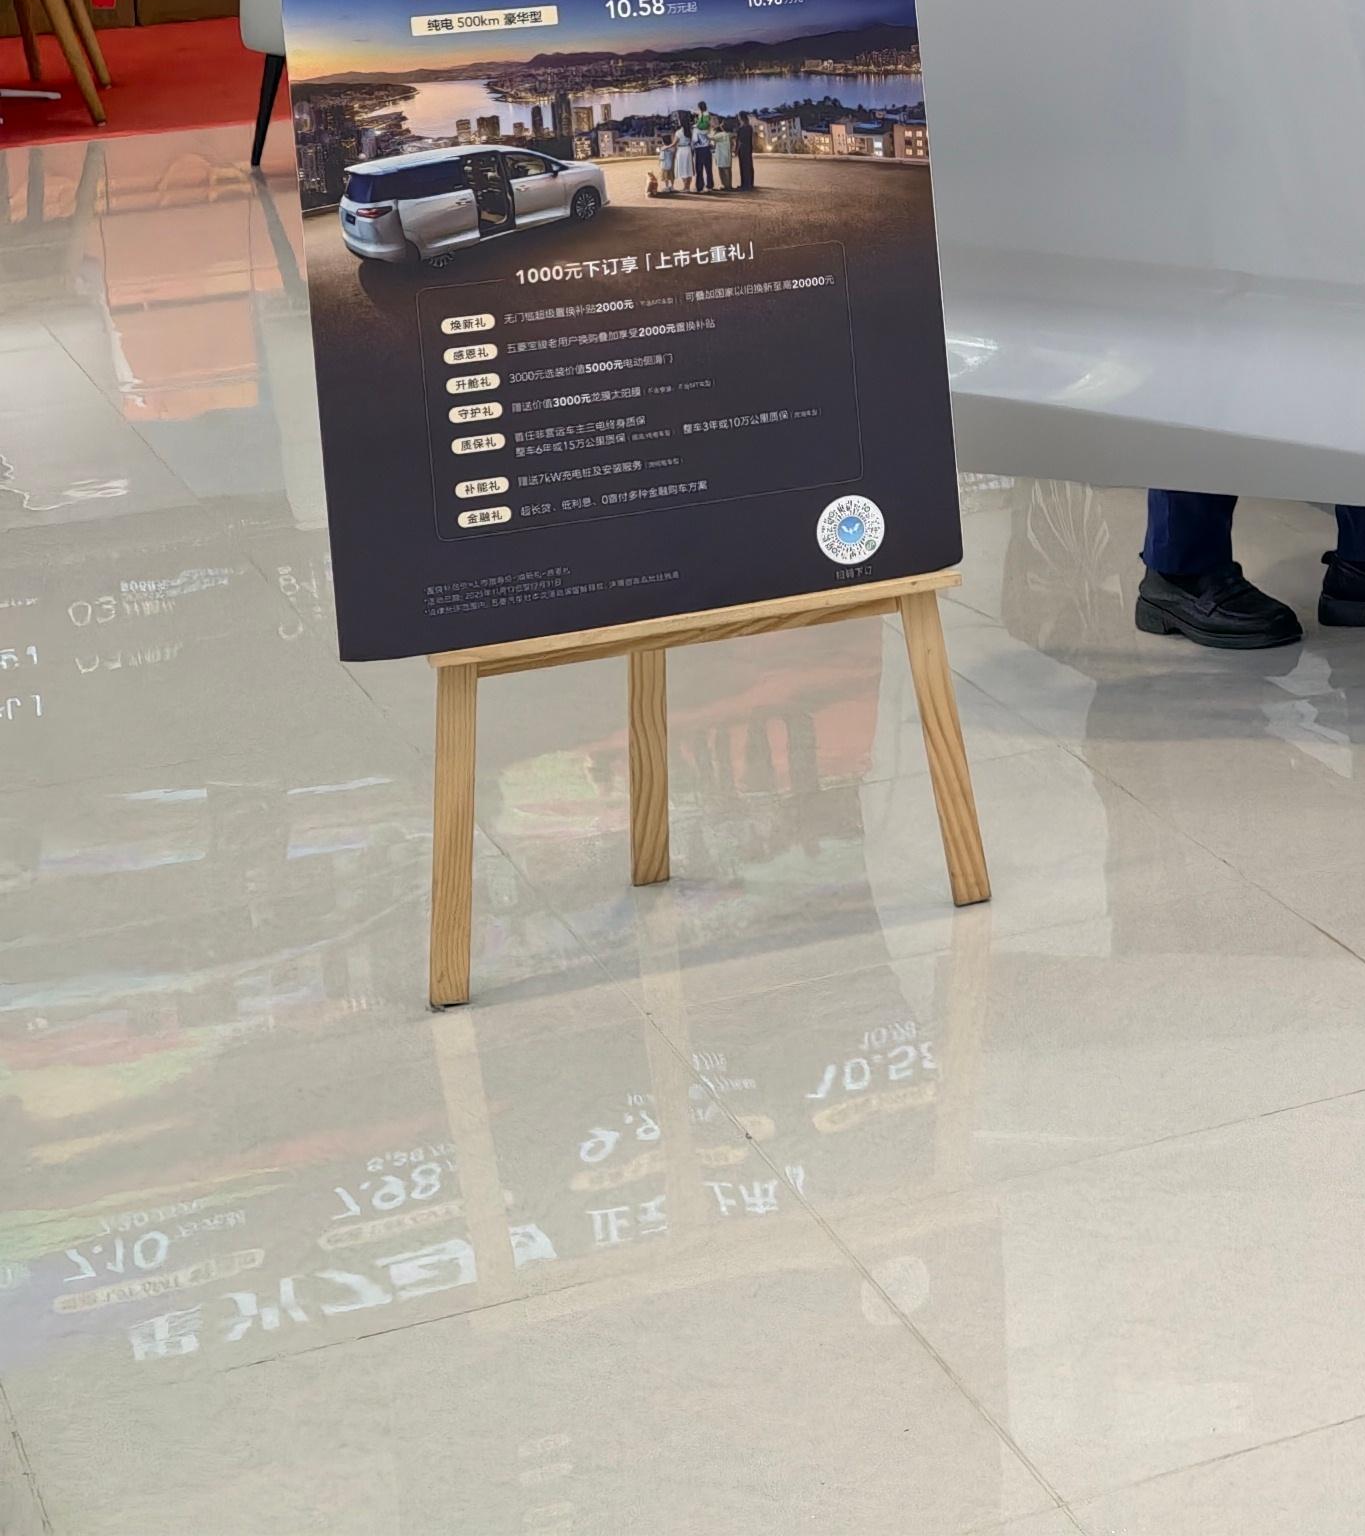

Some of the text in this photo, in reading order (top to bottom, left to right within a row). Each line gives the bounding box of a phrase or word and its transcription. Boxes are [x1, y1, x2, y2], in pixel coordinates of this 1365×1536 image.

[427, 10, 543, 32] 纯电 500km 豪华型
[449, 316, 487, 332] 焕新礼
[452, 346, 489, 361] 感恩礼
[455, 376, 492, 391] 升舱礼
[457, 405, 494, 420] 守护礼
[460, 436, 497, 451] 质保礼
[464, 480, 500, 495] 补能礼
[467, 509, 503, 524] 金融礼
